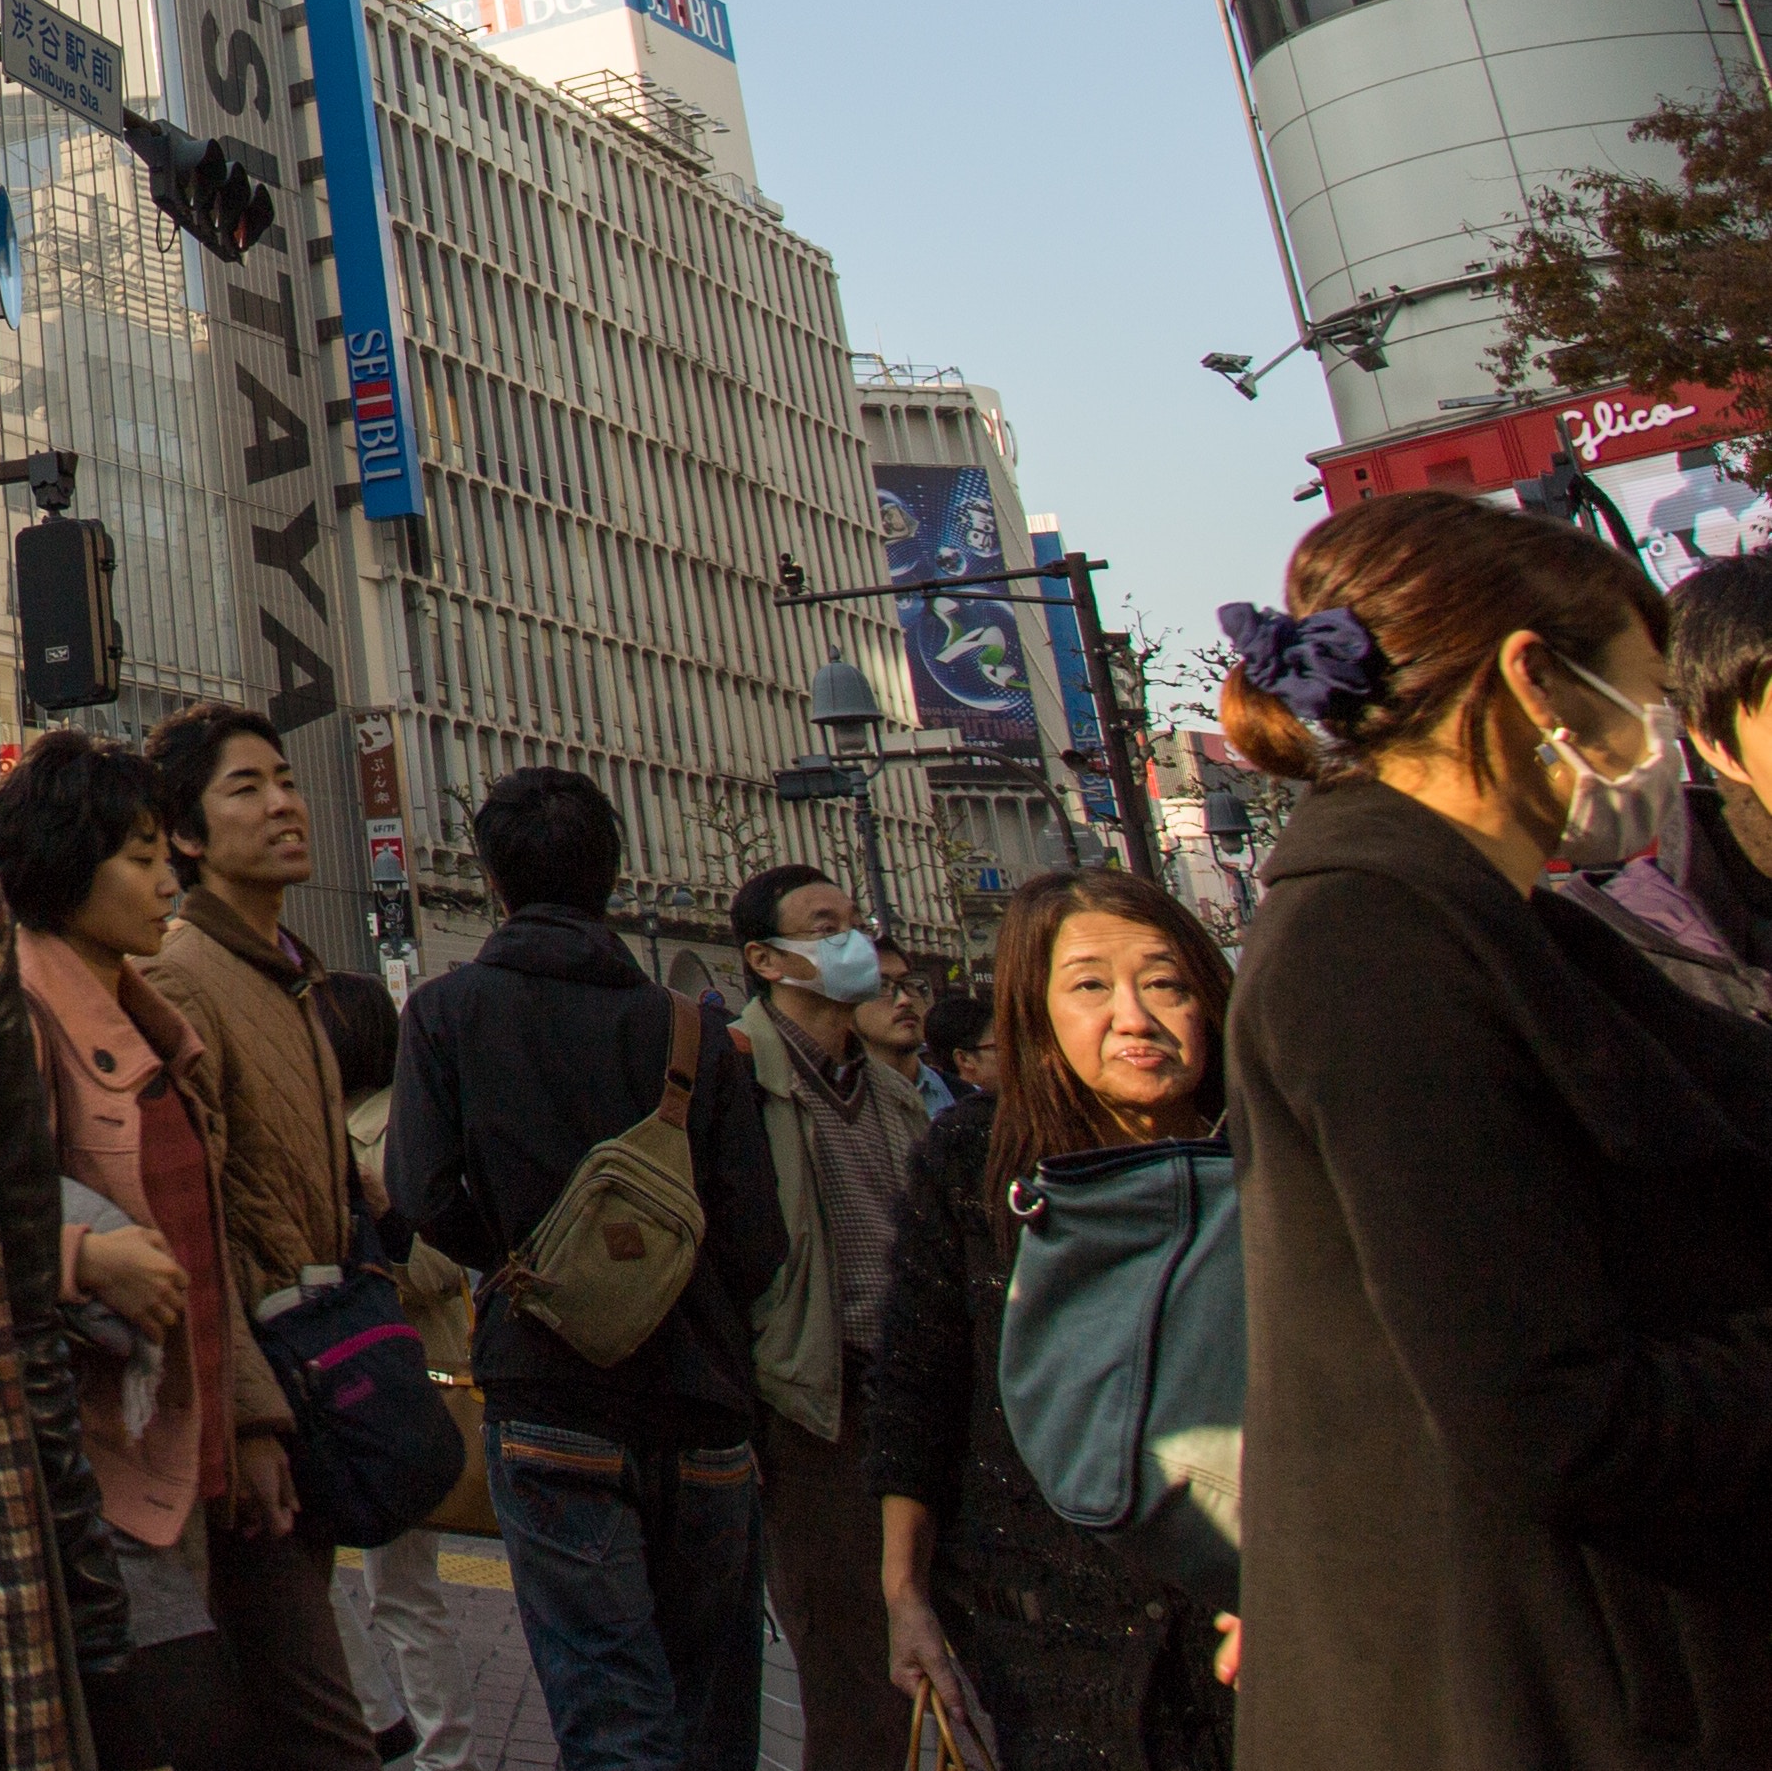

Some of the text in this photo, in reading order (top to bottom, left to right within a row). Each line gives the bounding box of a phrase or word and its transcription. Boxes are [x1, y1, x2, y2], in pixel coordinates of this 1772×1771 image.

[28, 54, 104, 116] Shibuya Sta.
[348, 328, 402, 485] SEIBU
[1563, 400, 1697, 462] Glico
